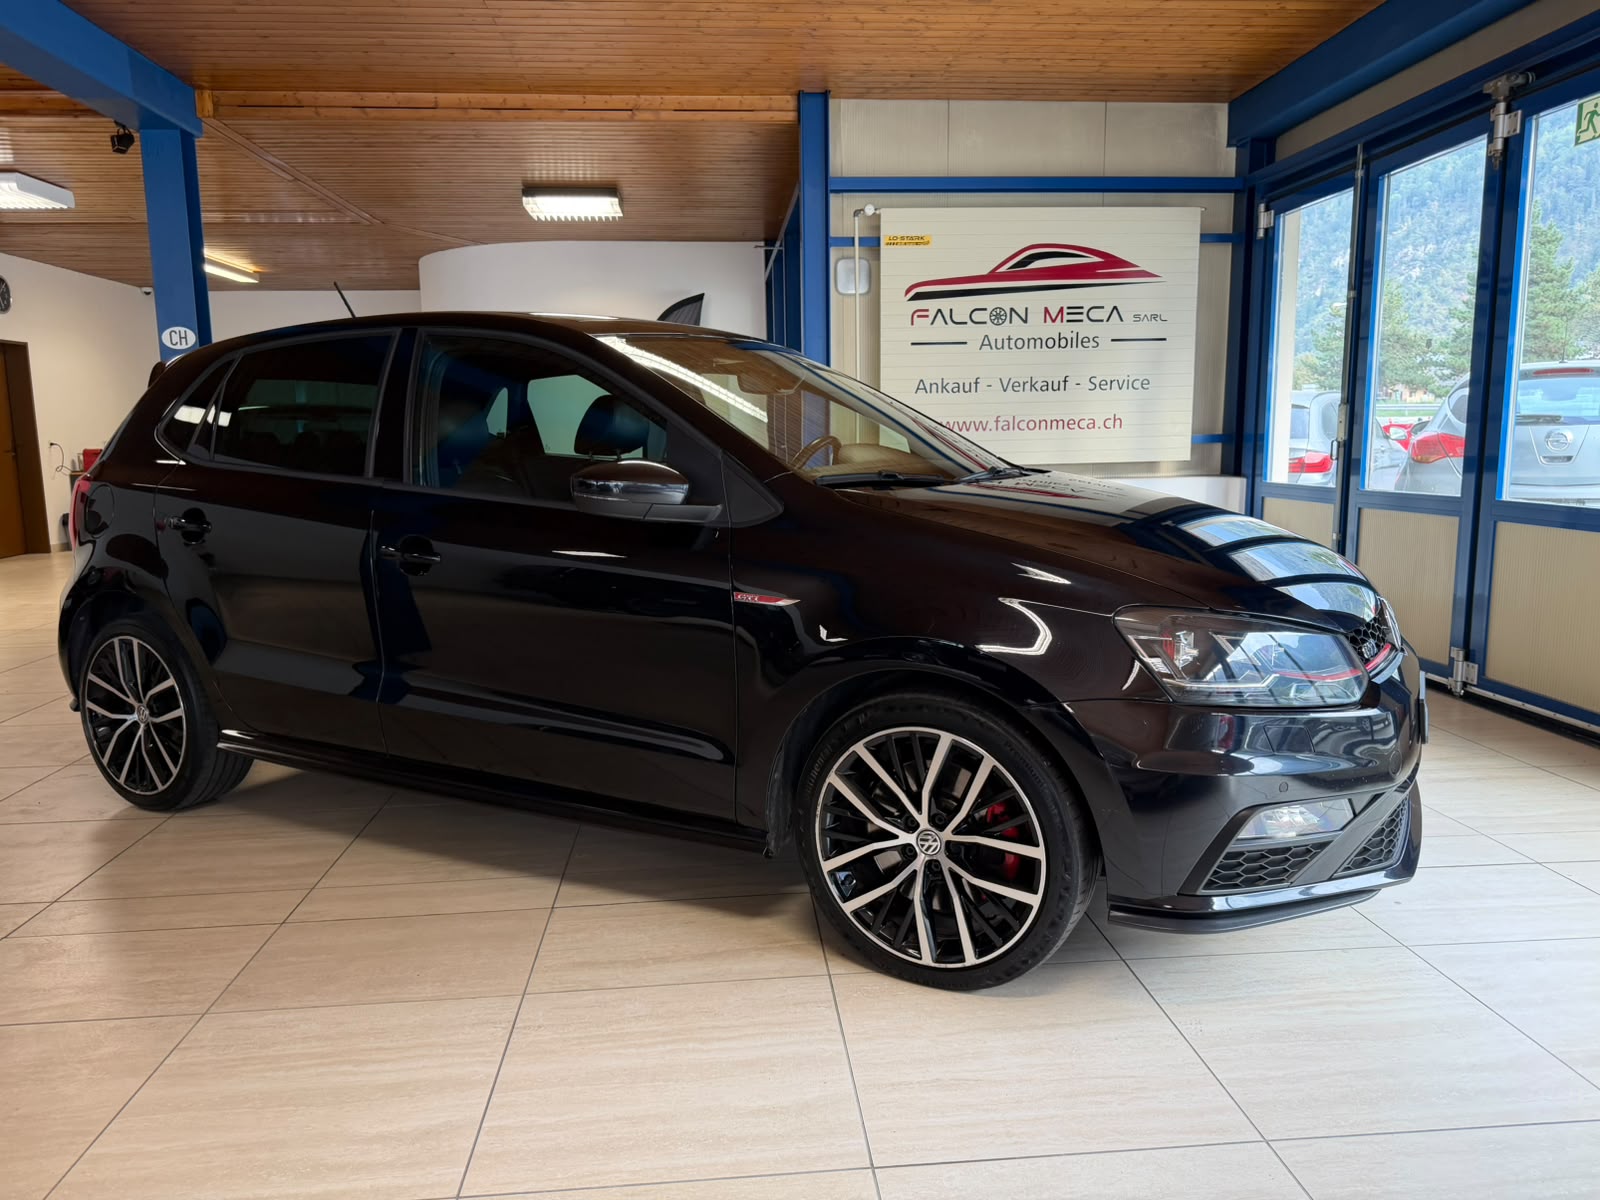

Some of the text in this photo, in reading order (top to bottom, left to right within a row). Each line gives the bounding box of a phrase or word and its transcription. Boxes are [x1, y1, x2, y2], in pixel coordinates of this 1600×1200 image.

[910, 305, 1169, 326] FALCON MECA SARL
[169, 330, 188, 346] CH
[979, 331, 1100, 350] Automobiles
[915, 377, 981, 394] Ankauf
[999, 375, 1070, 393] Verkauf
[1088, 375, 1151, 391] Service
